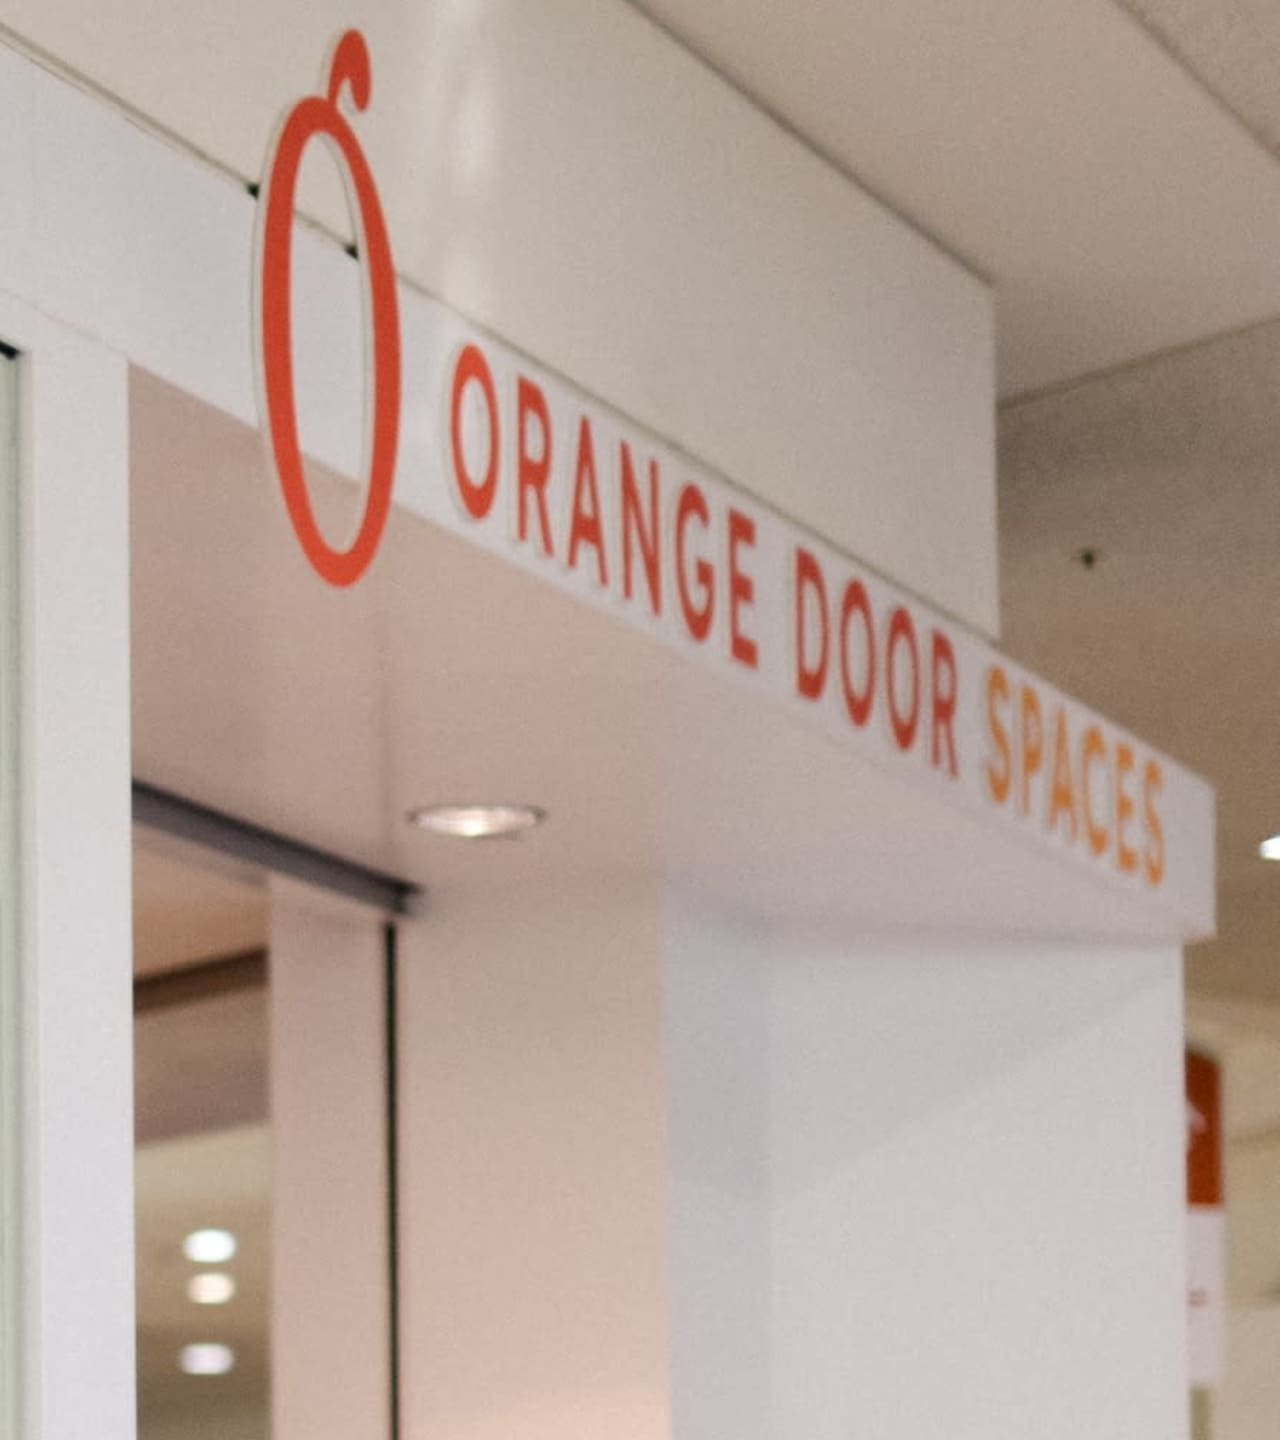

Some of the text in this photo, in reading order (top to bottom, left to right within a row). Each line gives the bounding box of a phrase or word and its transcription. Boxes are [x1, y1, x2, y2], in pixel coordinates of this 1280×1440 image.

[450, 344, 1166, 887] ORANGE DOOR SPACES
